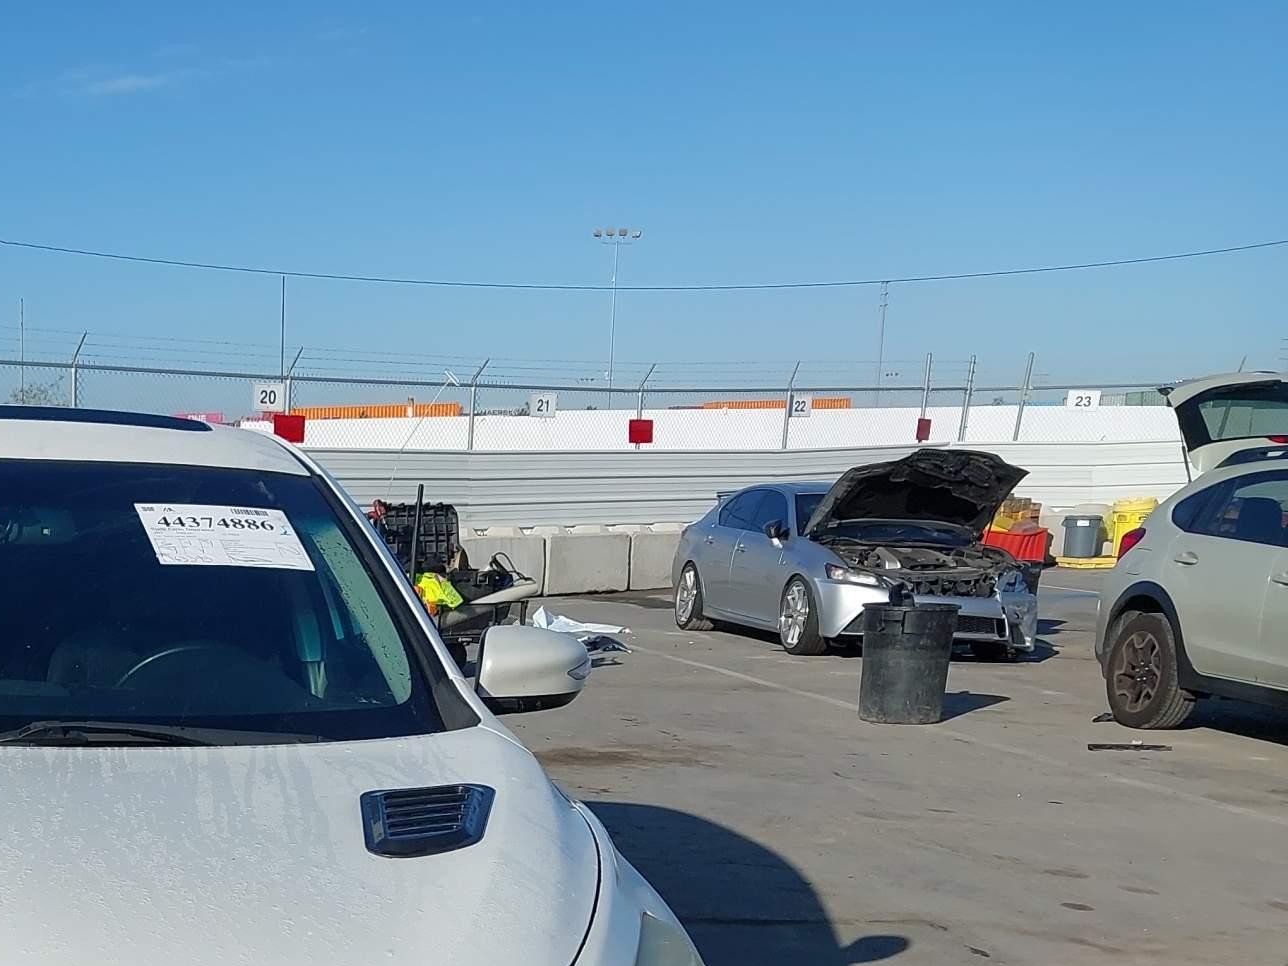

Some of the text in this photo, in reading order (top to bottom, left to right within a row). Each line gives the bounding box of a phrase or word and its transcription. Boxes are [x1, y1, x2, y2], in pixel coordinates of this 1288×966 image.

[259, 390, 277, 405] 20
[1075, 395, 1092, 408] 23
[536, 399, 550, 412] 21
[794, 400, 806, 412] 22
[157, 515, 275, 531] 44374886
